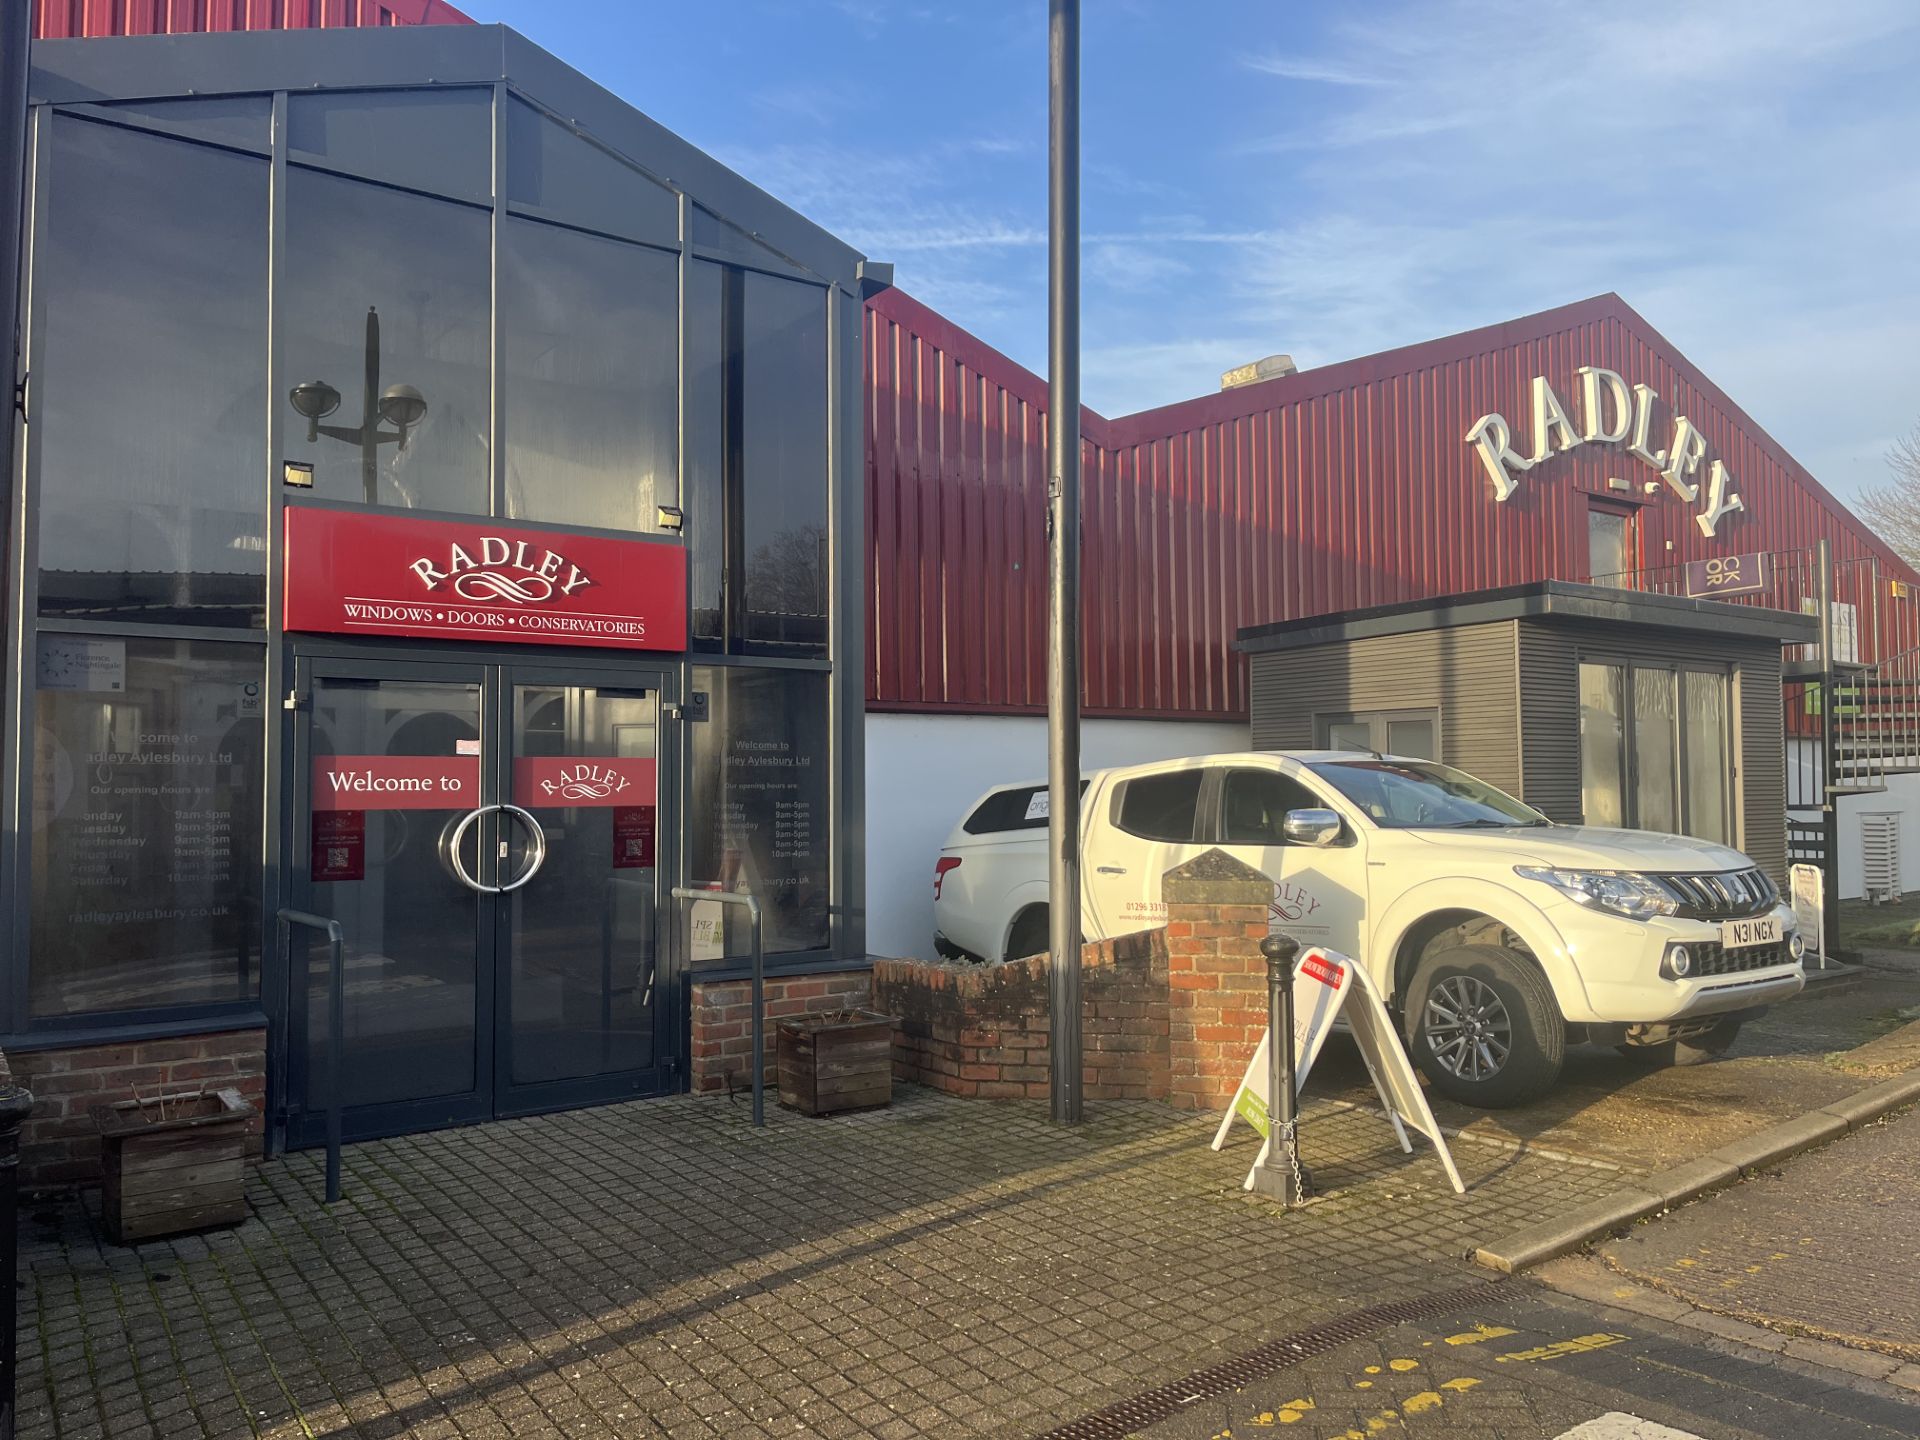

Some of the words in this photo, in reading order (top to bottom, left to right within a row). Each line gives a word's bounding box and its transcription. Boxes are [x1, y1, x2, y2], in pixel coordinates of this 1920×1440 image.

[1465, 365, 1744, 538] RADLEY
[409, 536, 590, 596] RADLEY
[344, 604, 433, 623] WINDOWS
[447, 610, 505, 627] DOORS
[518, 614, 645, 635] CONSERVATORIES
[183, 733, 199, 744] to
[735, 740, 777, 750] Welcome
[780, 740, 790, 750] to
[86, 752, 126, 765] adley
[129, 752, 205, 765] Aylesbury
[208, 752, 232, 764] Ltd
[747, 756, 793, 767] Aylesbury
[795, 756, 811, 766] Ltd
[327, 770, 433, 792] Welcome
[440, 775, 462, 792] to
[540, 764, 631, 796] RADLEY
[90, 786, 112, 794] Our
[114, 786, 158, 796] opening
[161, 785, 191, 794] hours
[738, 782, 766, 791] opening
[767, 782, 786, 790] hours
[775, 802, 810, 810] 9am-5pm
[174, 809, 231, 821] 9am-5pm
[775, 811, 810, 820] 9am-5pm
[174, 822, 231, 833] 9am-5pm
[775, 821, 810, 829] 9am-5pm
[174, 834, 231, 846] 9am-5pm
[775, 831, 810, 839] 9am-5pm
[775, 840, 810, 848] 9am-5pm
[174, 847, 230, 857] 9am-5pm
[772, 850, 810, 858] 10am-4pm
[1126, 902, 1148, 911] 01296
[1733, 924, 1752, 944] N31
[1754, 920, 1774, 941] NGX
